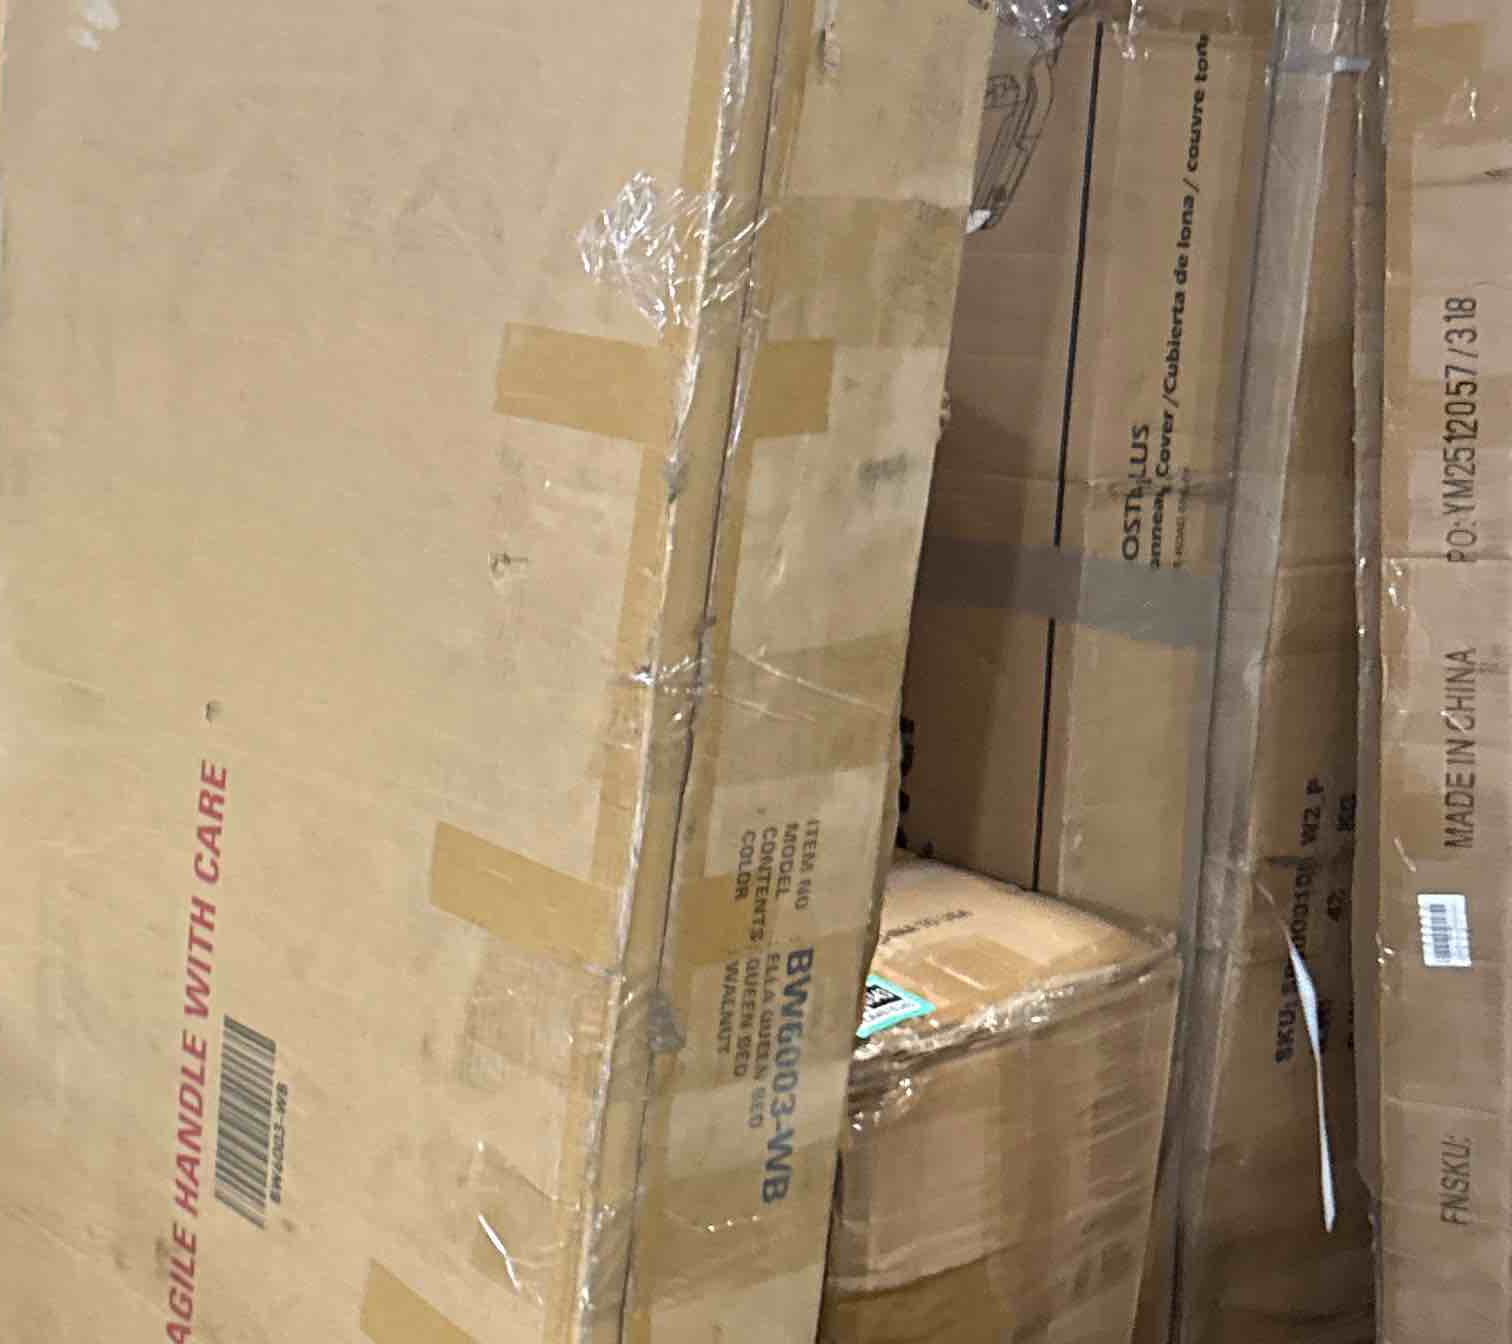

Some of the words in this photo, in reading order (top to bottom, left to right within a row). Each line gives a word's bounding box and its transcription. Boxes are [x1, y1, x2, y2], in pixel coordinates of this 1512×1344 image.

[1187, 90, 1205, 173] couvre
[1176, 194, 1195, 249] lona
[1174, 254, 1189, 285] de
[1155, 409, 1174, 478] Cover
[1444, 647, 1477, 734] CHINA
[1446, 739, 1476, 766] IN
[193, 759, 228, 885] CARE
[799, 819, 820, 873] ITEM
[1444, 771, 1476, 849] MADE
[734, 829, 757, 902] COLOR
[749, 825, 778, 944] CONTENTS
[775, 820, 799, 902] MODEL
[794, 878, 811, 911] NO
[183, 895, 216, 1018] WITH
[739, 956, 760, 1029] QUEEN
[717, 959, 739, 1055] WALNUT
[733, 1035, 752, 1078] BED
[761, 944, 814, 1204] BW6003-WB
[173, 1029, 207, 1218] HANDLE
[1439, 1134, 1473, 1226] FNSKU:
